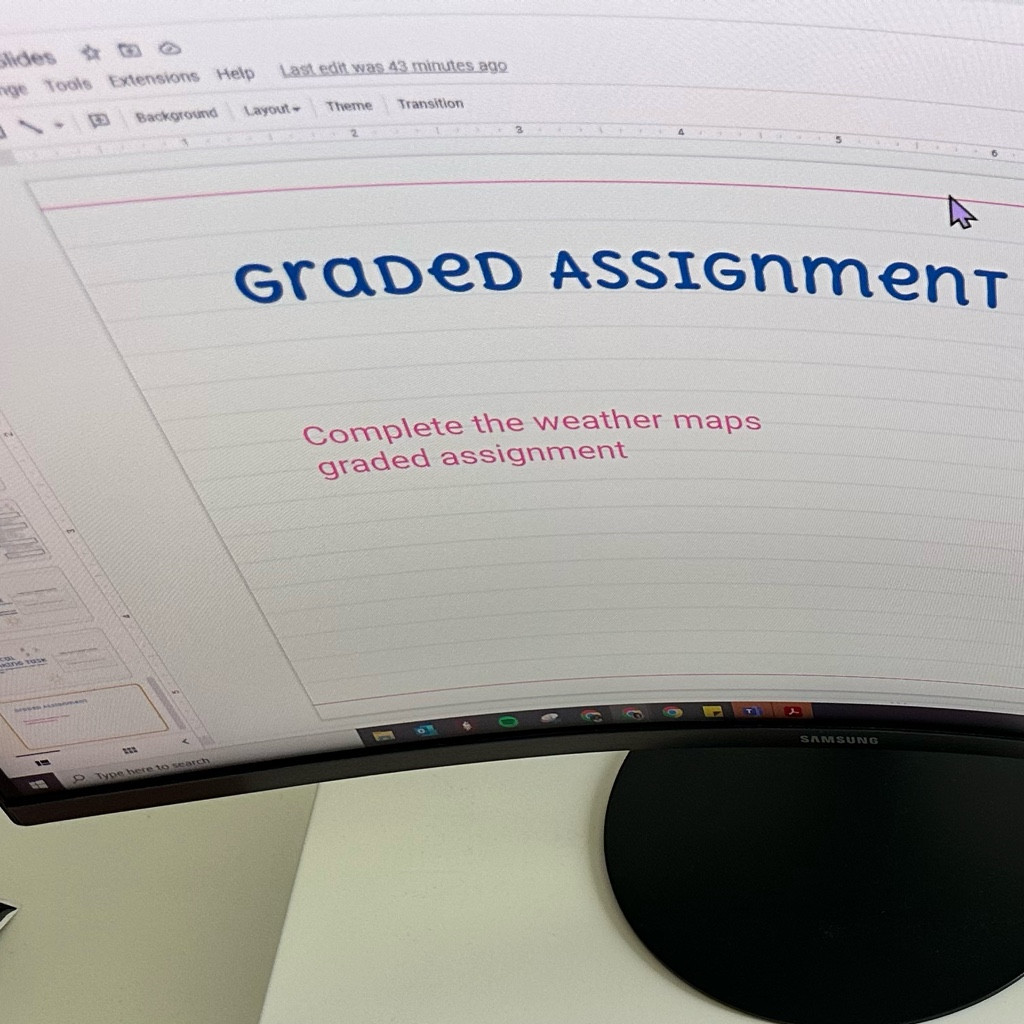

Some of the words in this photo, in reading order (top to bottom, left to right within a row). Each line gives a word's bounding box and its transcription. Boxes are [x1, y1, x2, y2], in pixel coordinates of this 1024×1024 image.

[43, 77, 93, 92] Tools
[108, 70, 200, 89] Extensions
[216, 66, 255, 82] Help
[278, 62, 315, 77] Last
[319, 60, 349, 75] edit
[352, 62, 384, 74] was
[387, 60, 408, 73] 43
[412, 58, 475, 73] minutes
[478, 61, 508, 75] ago
[135, 107, 218, 124] Background
[244, 102, 290, 118] Layout
[326, 100, 373, 113] Theme
[397, 97, 465, 111] Transition
[302, 417, 464, 446] Complete
[471, 412, 525, 434] the
[532, 408, 663, 432] weather
[673, 414, 762, 435] maps
[317, 447, 431, 481] graded
[440, 441, 629, 467] assignment
[799, 734, 880, 746] SAMSUNG
[94, 770, 124, 782] Type
[126, 766, 153, 776] here
[155, 763, 169, 771] to
[172, 757, 211, 770] search
